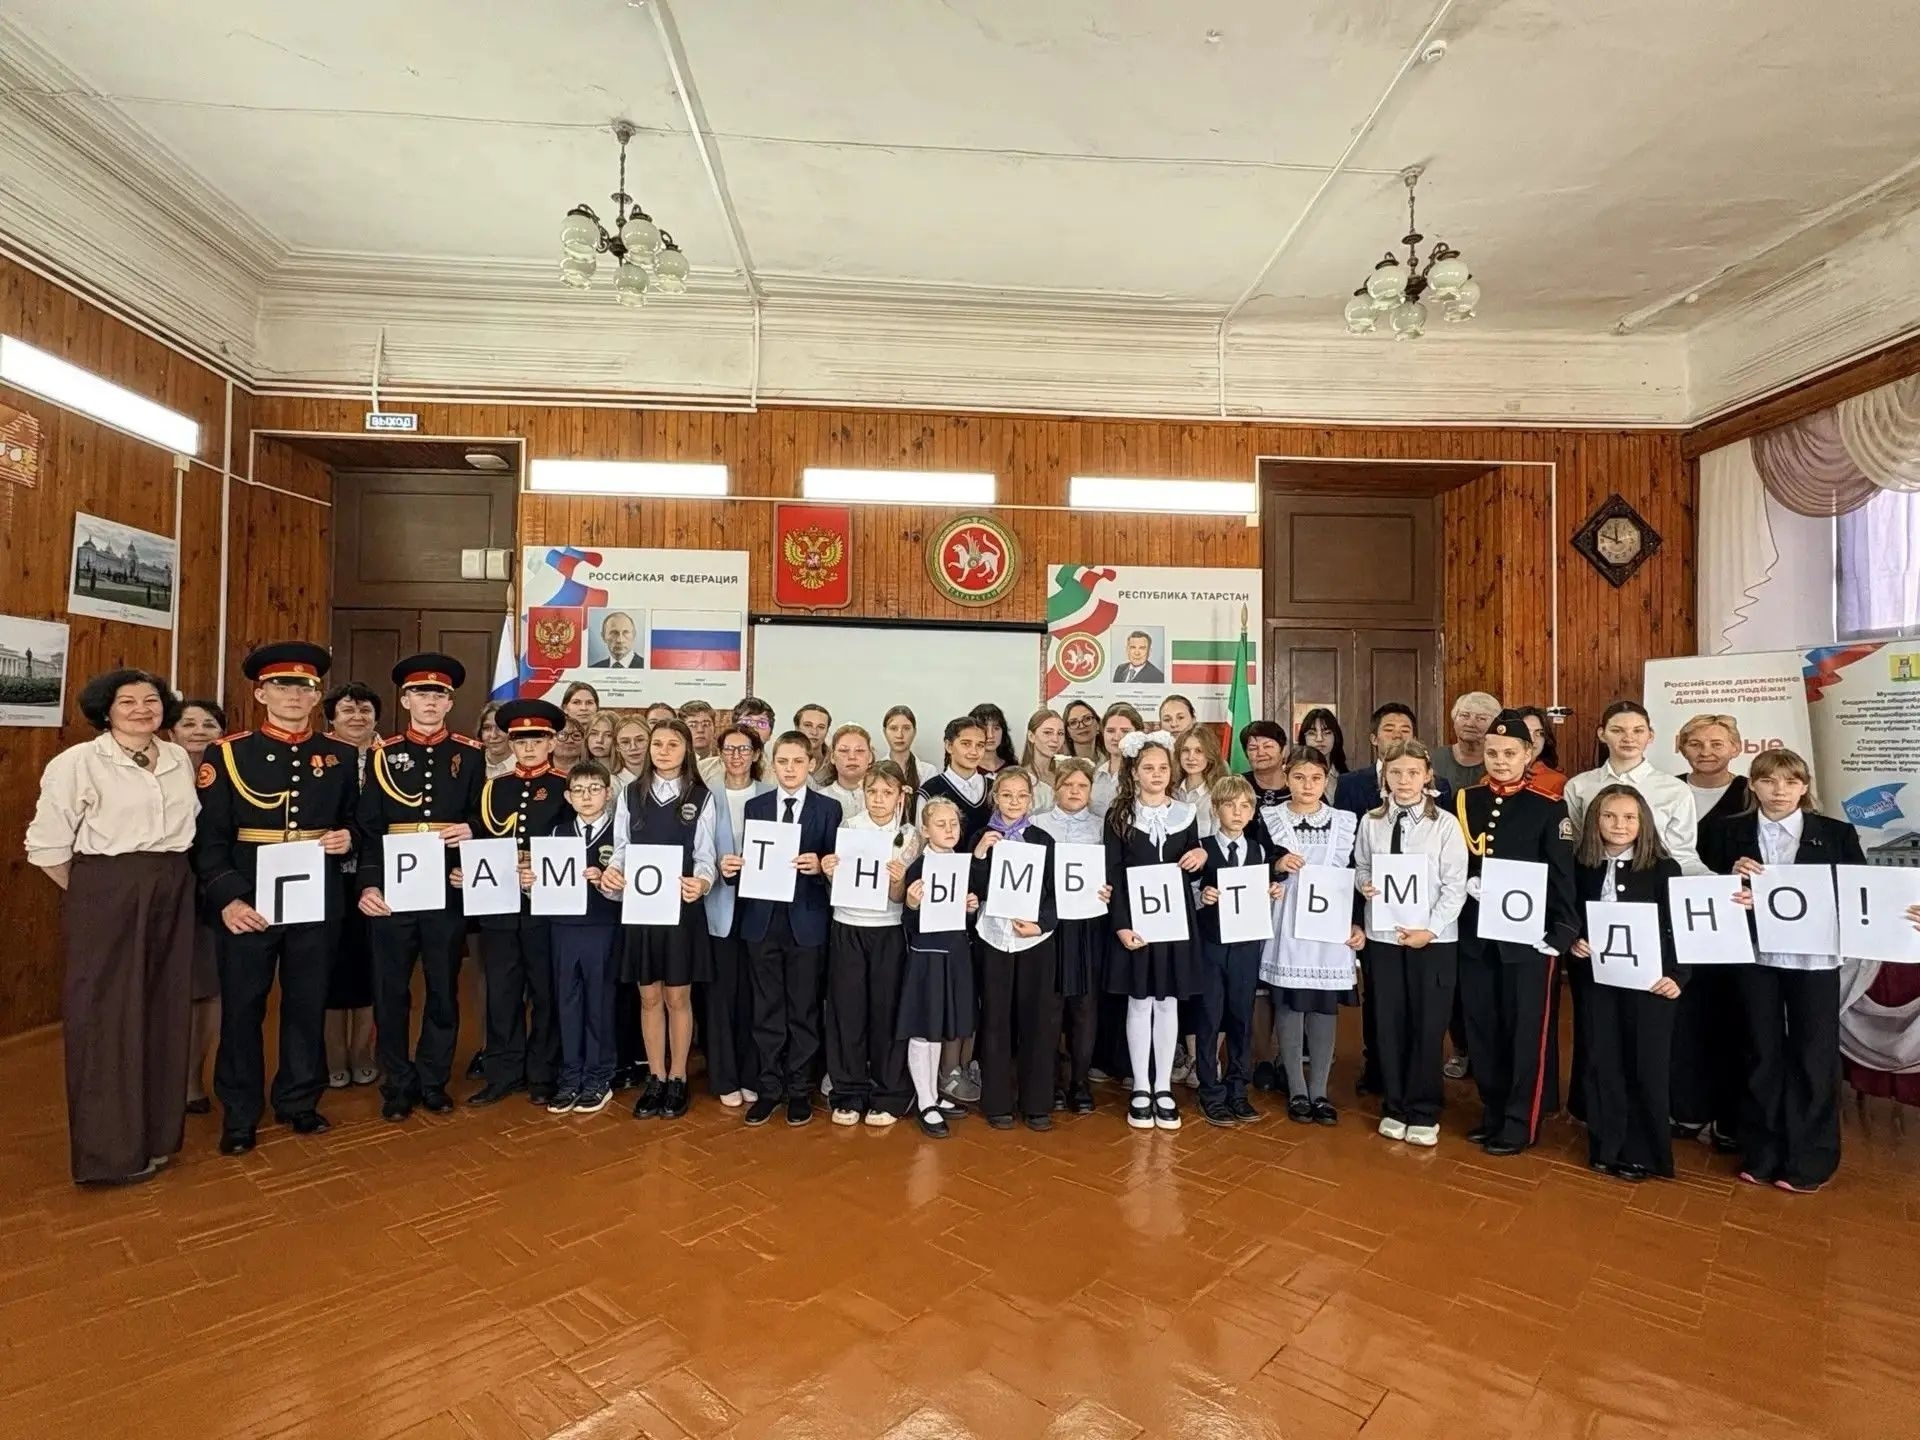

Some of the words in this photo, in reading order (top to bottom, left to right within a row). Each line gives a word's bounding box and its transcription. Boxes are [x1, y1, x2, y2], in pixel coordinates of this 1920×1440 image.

[371, 416, 411, 427] ВЫХОД
[588, 570, 665, 583] РОССИЙСКАЯ
[670, 573, 739, 585] ФЕДЕРАЦИЯ
[1118, 589, 1188, 601] РЕСПУБЛИКА
[1191, 591, 1250, 602] ТАТАРСТАН
[1663, 678, 1733, 689] Российское
[1733, 675, 1801, 687] движение
[1675, 687, 1709, 696] детей
[398, 853, 418, 883] Р
[752, 839, 775, 871] Т
[471, 858, 498, 888] А
[542, 857, 576, 887] М
[634, 865, 663, 895] О
[855, 857, 880, 889] Н
[1000, 860, 1034, 893] М
[1065, 863, 1084, 892] Б
[274, 873, 311, 923] Г
[930, 873, 956, 903] Ы
[1139, 884, 1171, 914] Ы
[1226, 885, 1247, 915] Т
[1308, 884, 1329, 914] Ь
[1384, 874, 1418, 904] М
[1501, 889, 1534, 922] О
[1685, 897, 1719, 932] Н
[1768, 886, 1808, 922] О
[1599, 924, 1639, 967] Д
